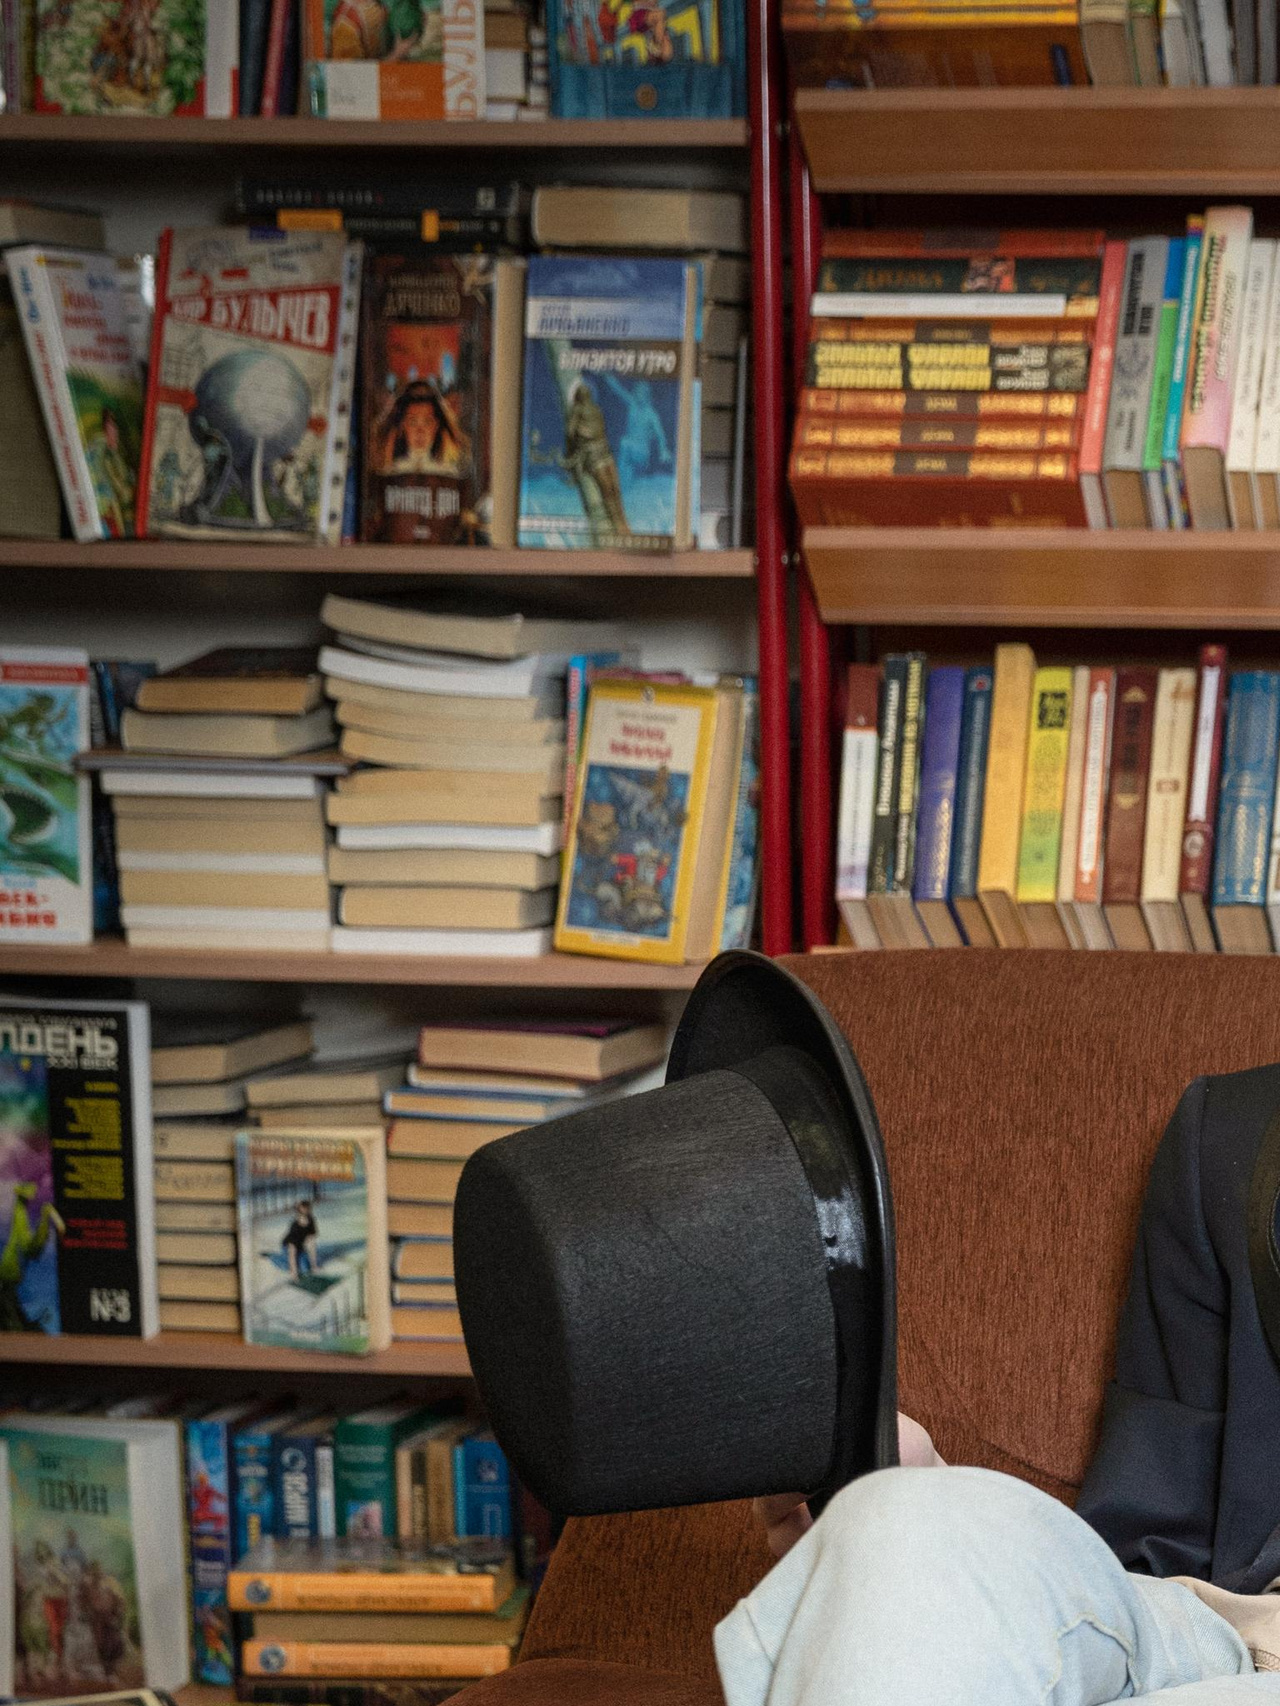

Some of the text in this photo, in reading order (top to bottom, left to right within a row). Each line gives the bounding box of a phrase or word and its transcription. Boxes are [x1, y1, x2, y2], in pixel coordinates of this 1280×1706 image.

[211, 290, 332, 349] БУЛЫЧЕВ
[559, 349, 677, 375] БЛИЗИТСЯ УТРО
